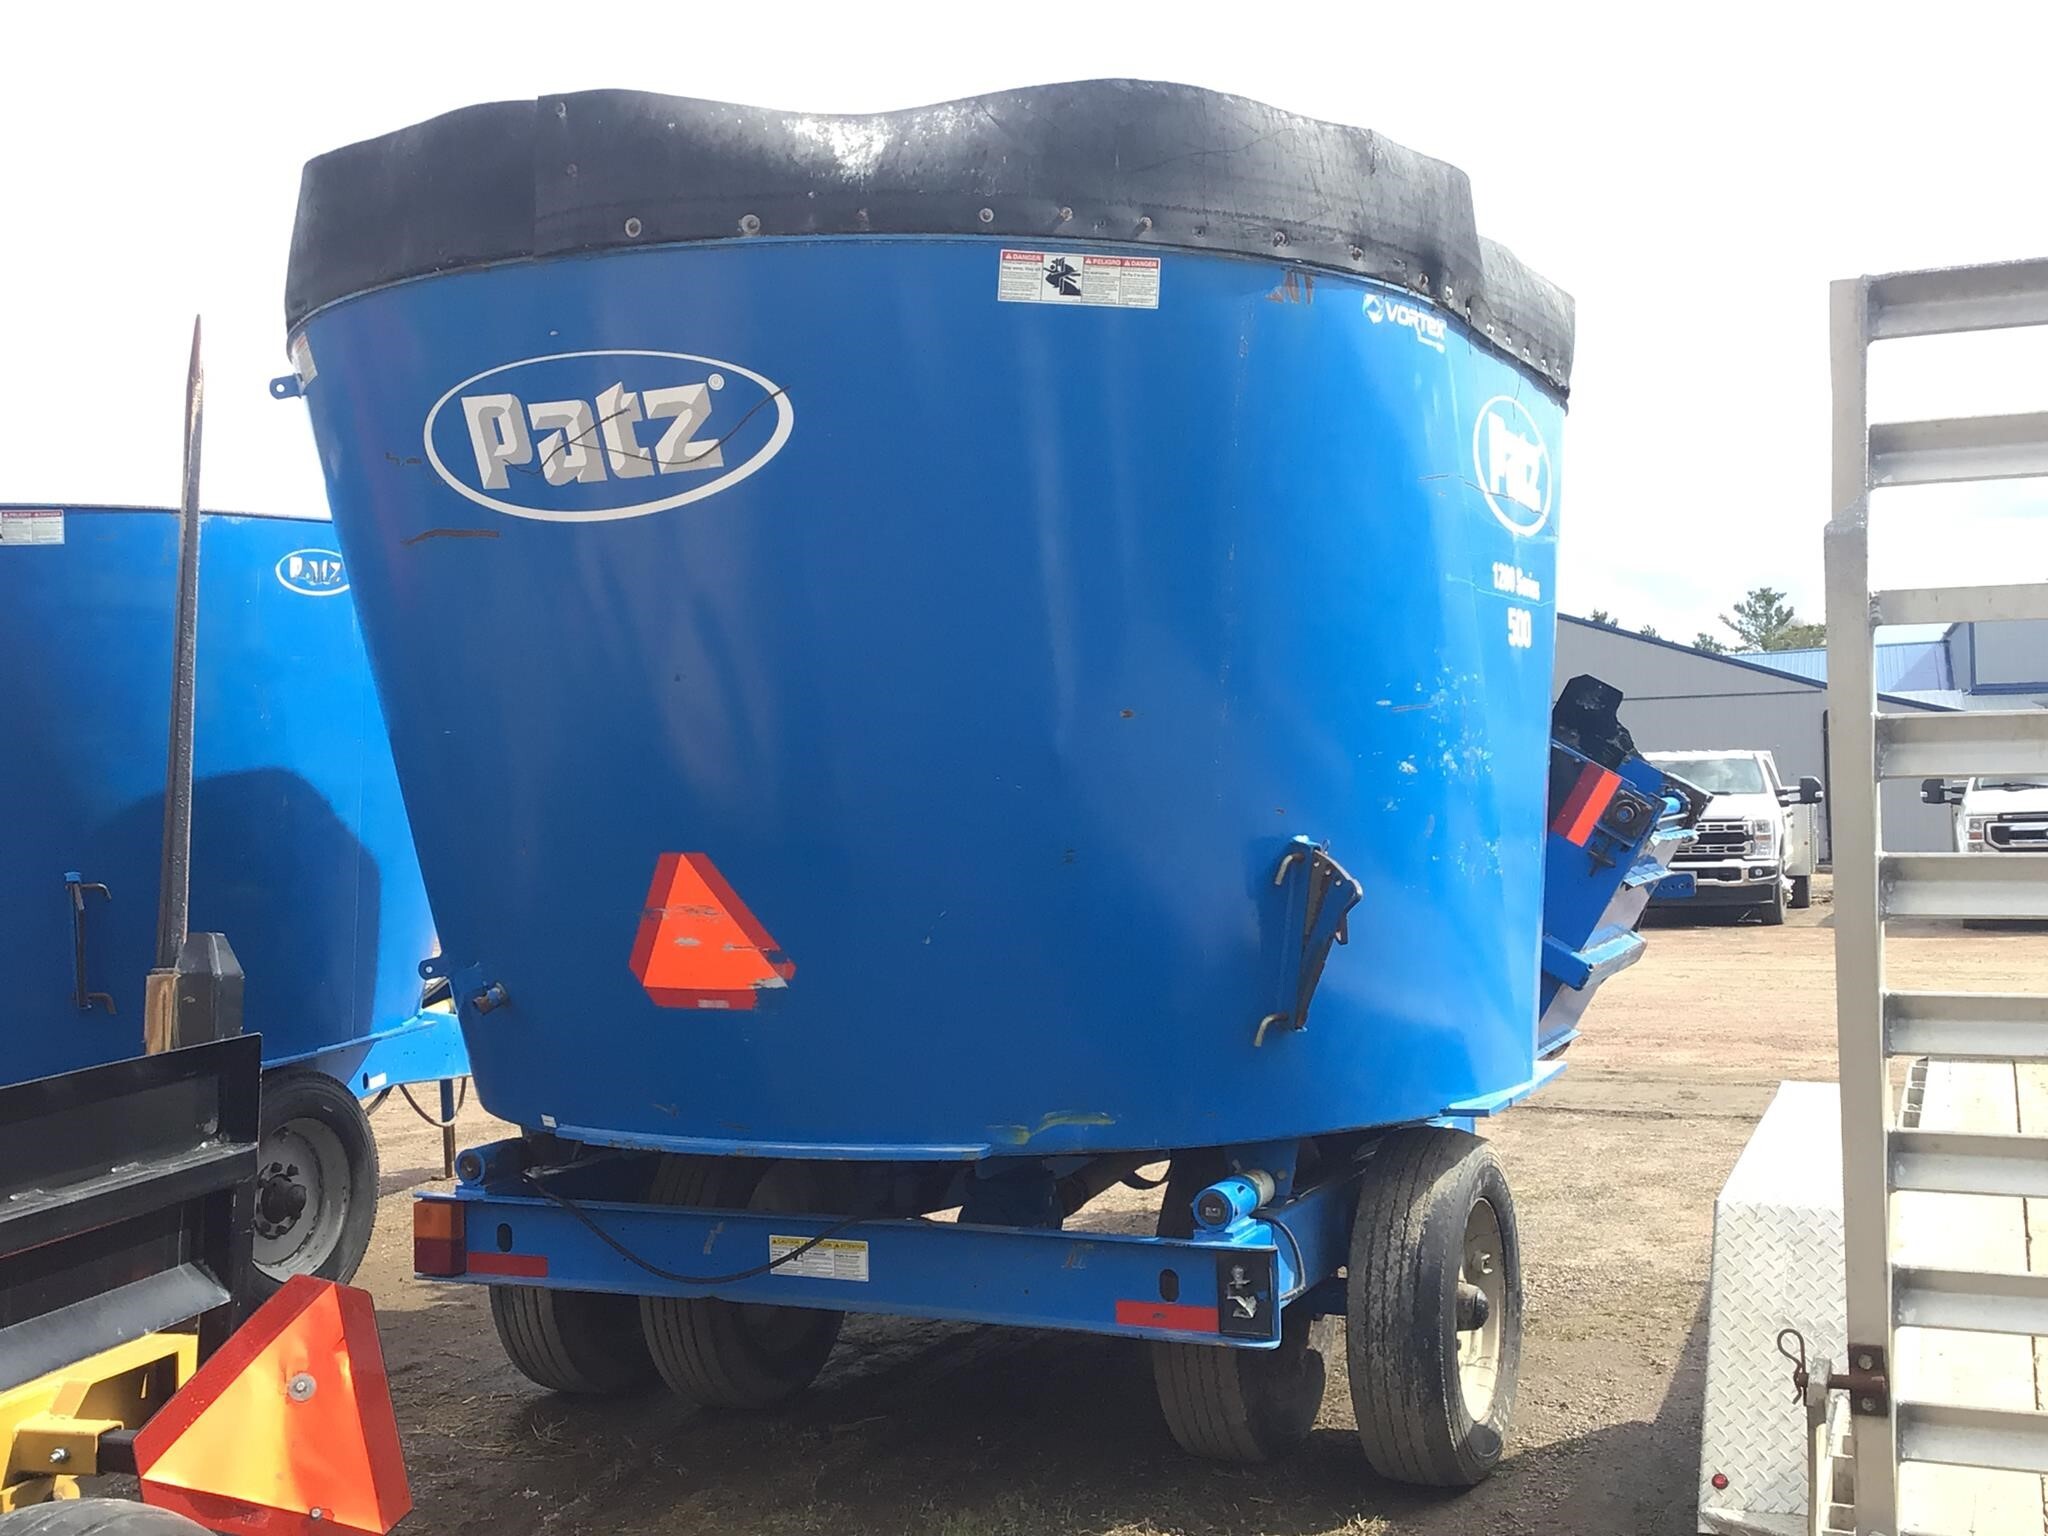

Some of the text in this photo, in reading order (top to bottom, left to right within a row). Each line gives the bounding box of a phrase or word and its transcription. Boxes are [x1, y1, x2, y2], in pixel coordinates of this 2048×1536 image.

[1012, 253, 1041, 261] DANGER
[1092, 258, 1121, 266] PELIGRO
[1507, 607, 1532, 648] 500
